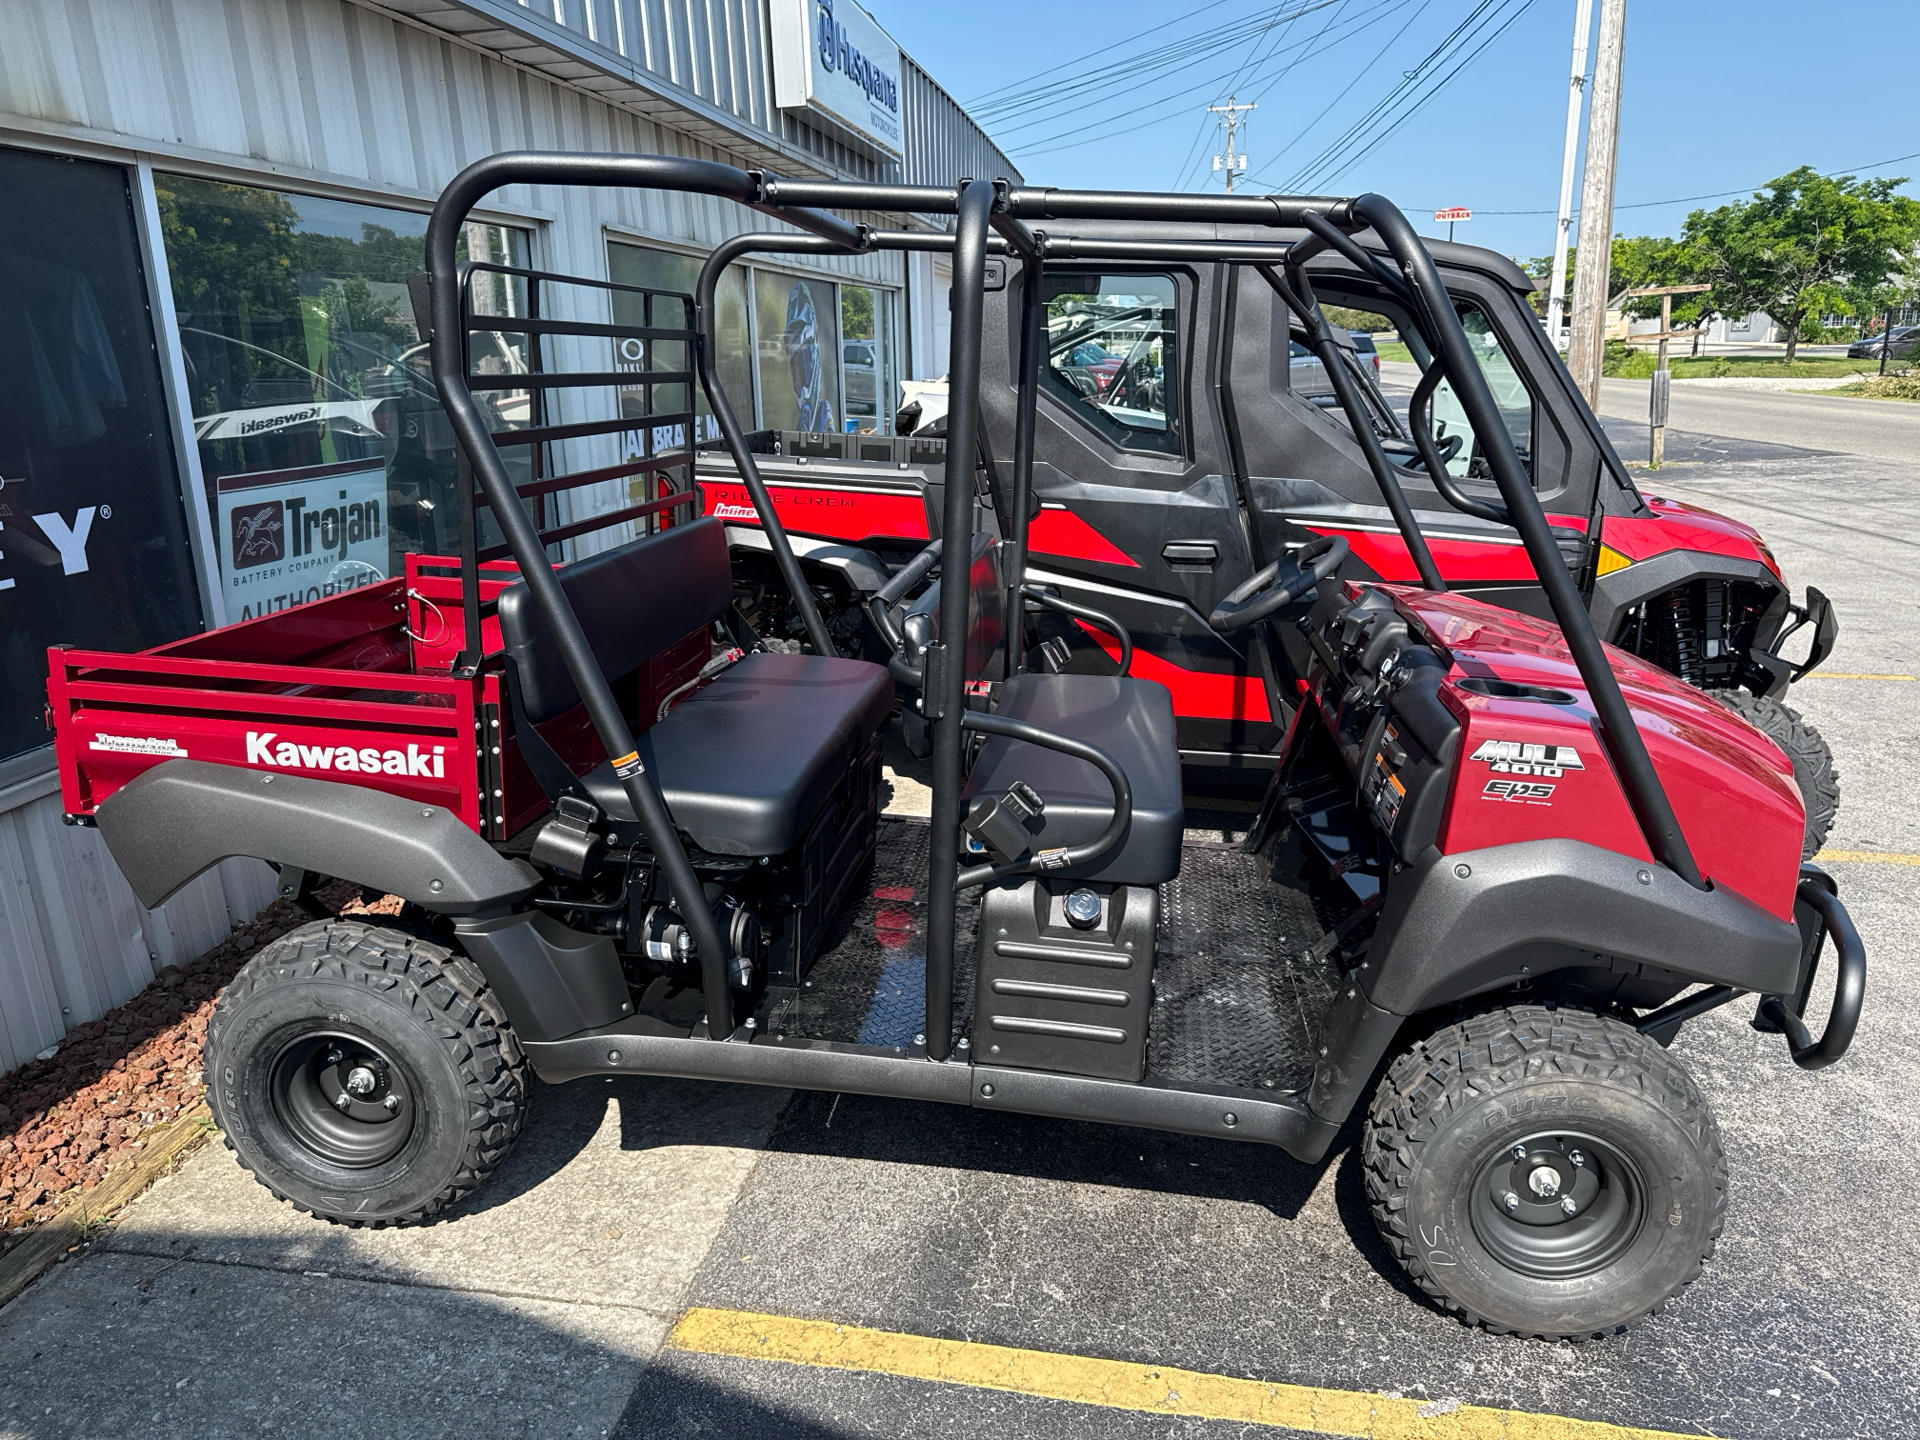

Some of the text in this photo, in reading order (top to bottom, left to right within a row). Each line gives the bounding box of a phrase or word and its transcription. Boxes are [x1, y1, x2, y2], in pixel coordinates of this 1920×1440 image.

[870, 110, 898, 141] MOTORCYCLES
[715, 490, 854, 508] RIDE CREW
[285, 489, 380, 561] Trojan
[233, 554, 335, 587] BATTERY COMPANY
[246, 731, 445, 778] Kawasaki
[1490, 763, 1563, 778] 4010
[1483, 1096, 1599, 1133] DURO
